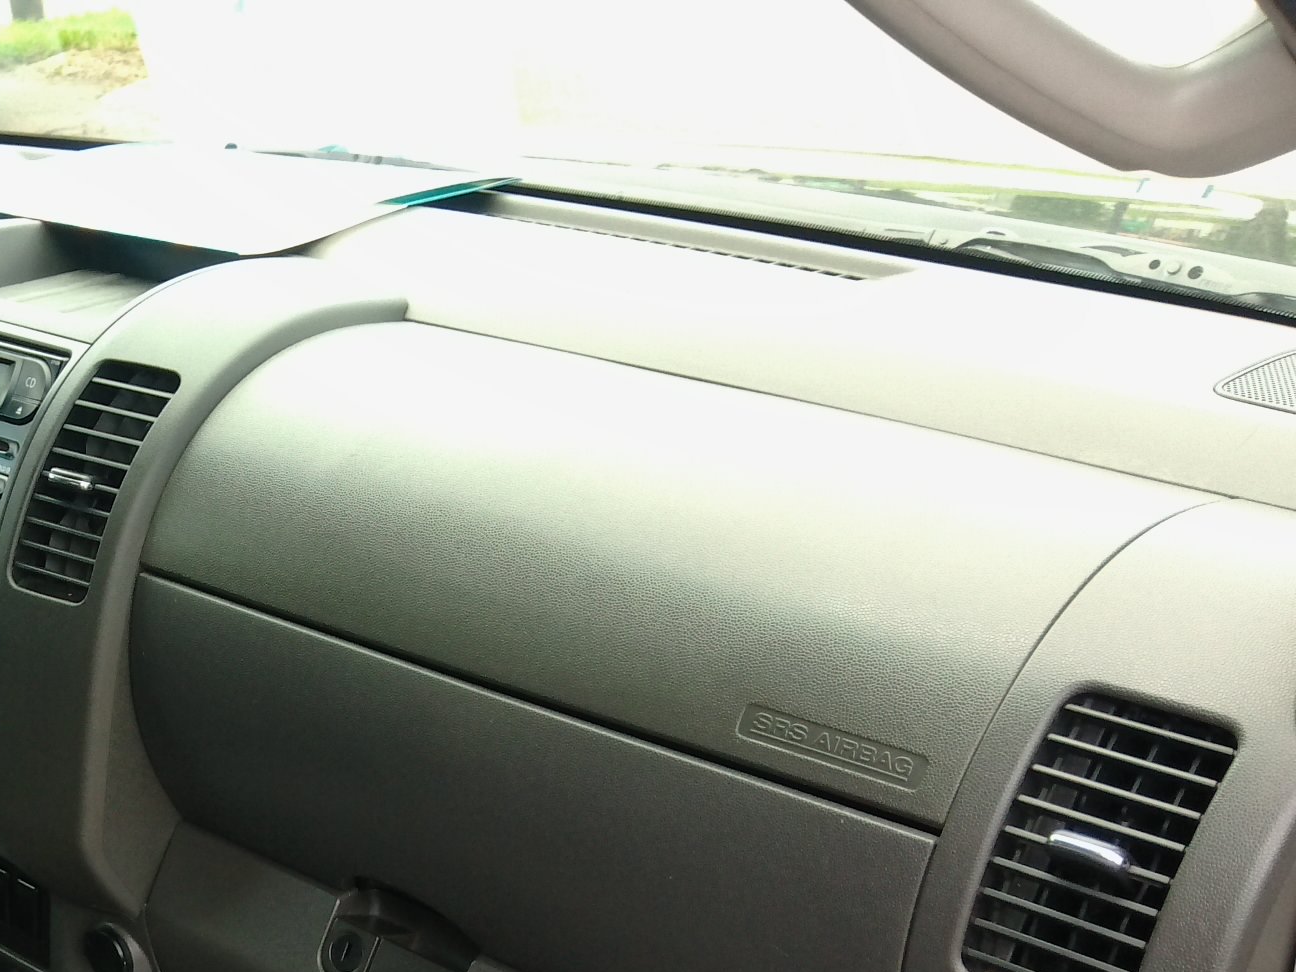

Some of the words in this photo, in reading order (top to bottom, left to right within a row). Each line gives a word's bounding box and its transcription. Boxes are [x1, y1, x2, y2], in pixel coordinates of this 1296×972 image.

[25, 376, 37, 389] CD
[752, 711, 810, 741] SRS
[813, 731, 915, 777] AIRBAG
